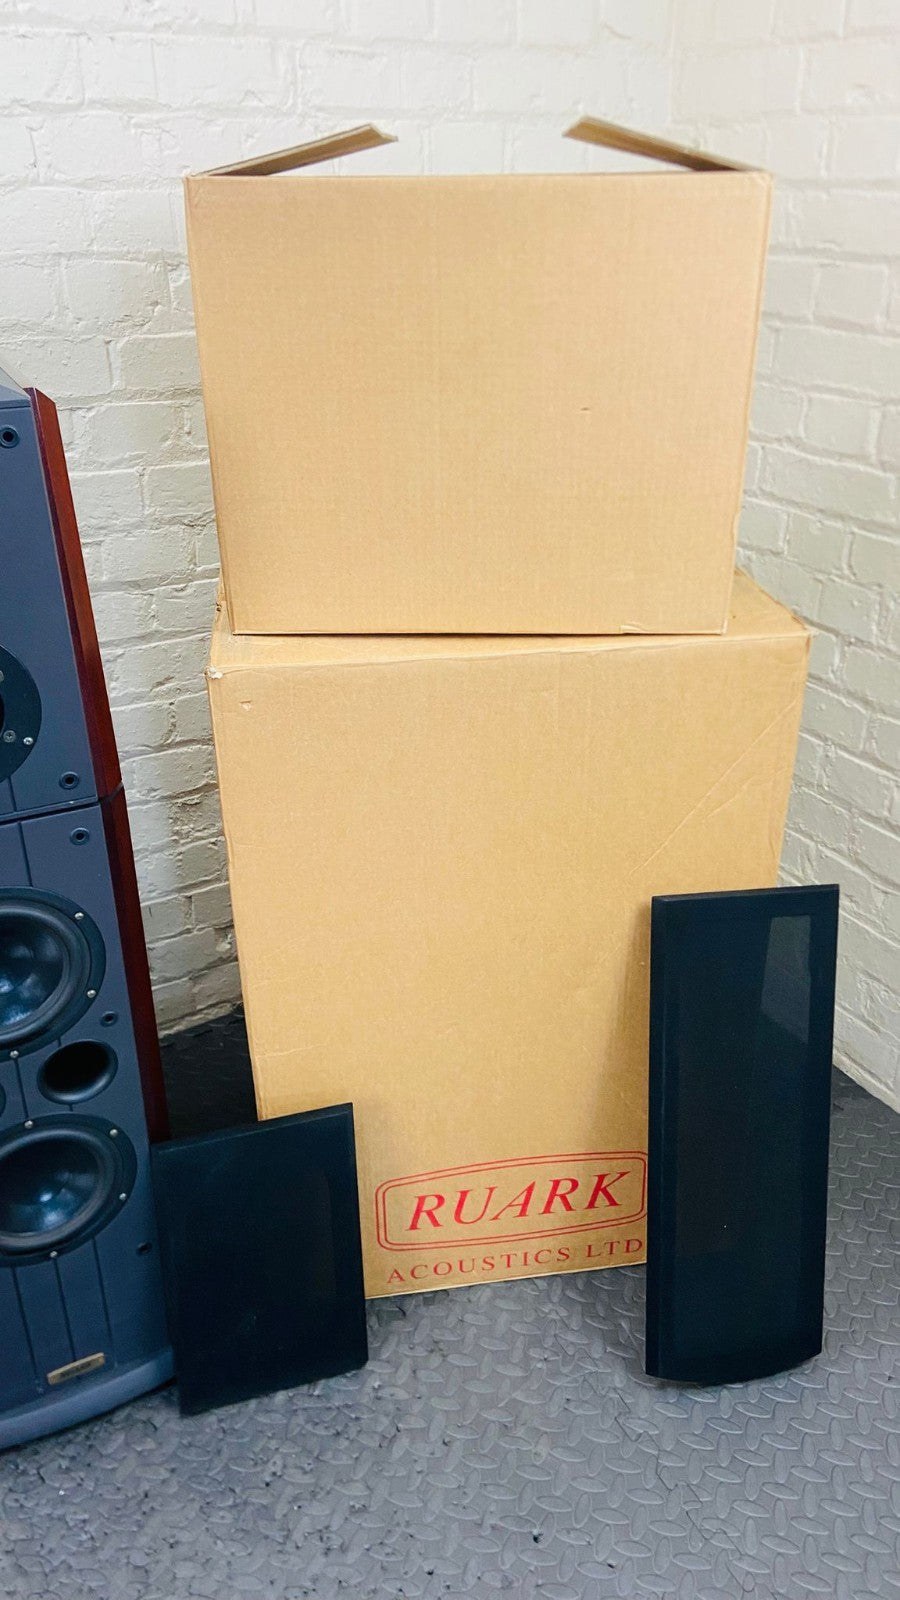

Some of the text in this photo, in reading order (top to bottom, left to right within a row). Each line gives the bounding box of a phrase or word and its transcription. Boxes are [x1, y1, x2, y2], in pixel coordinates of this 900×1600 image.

[405, 1170, 631, 1232] RUARK
[386, 1238, 643, 1284] ACOUSTICS LTD
